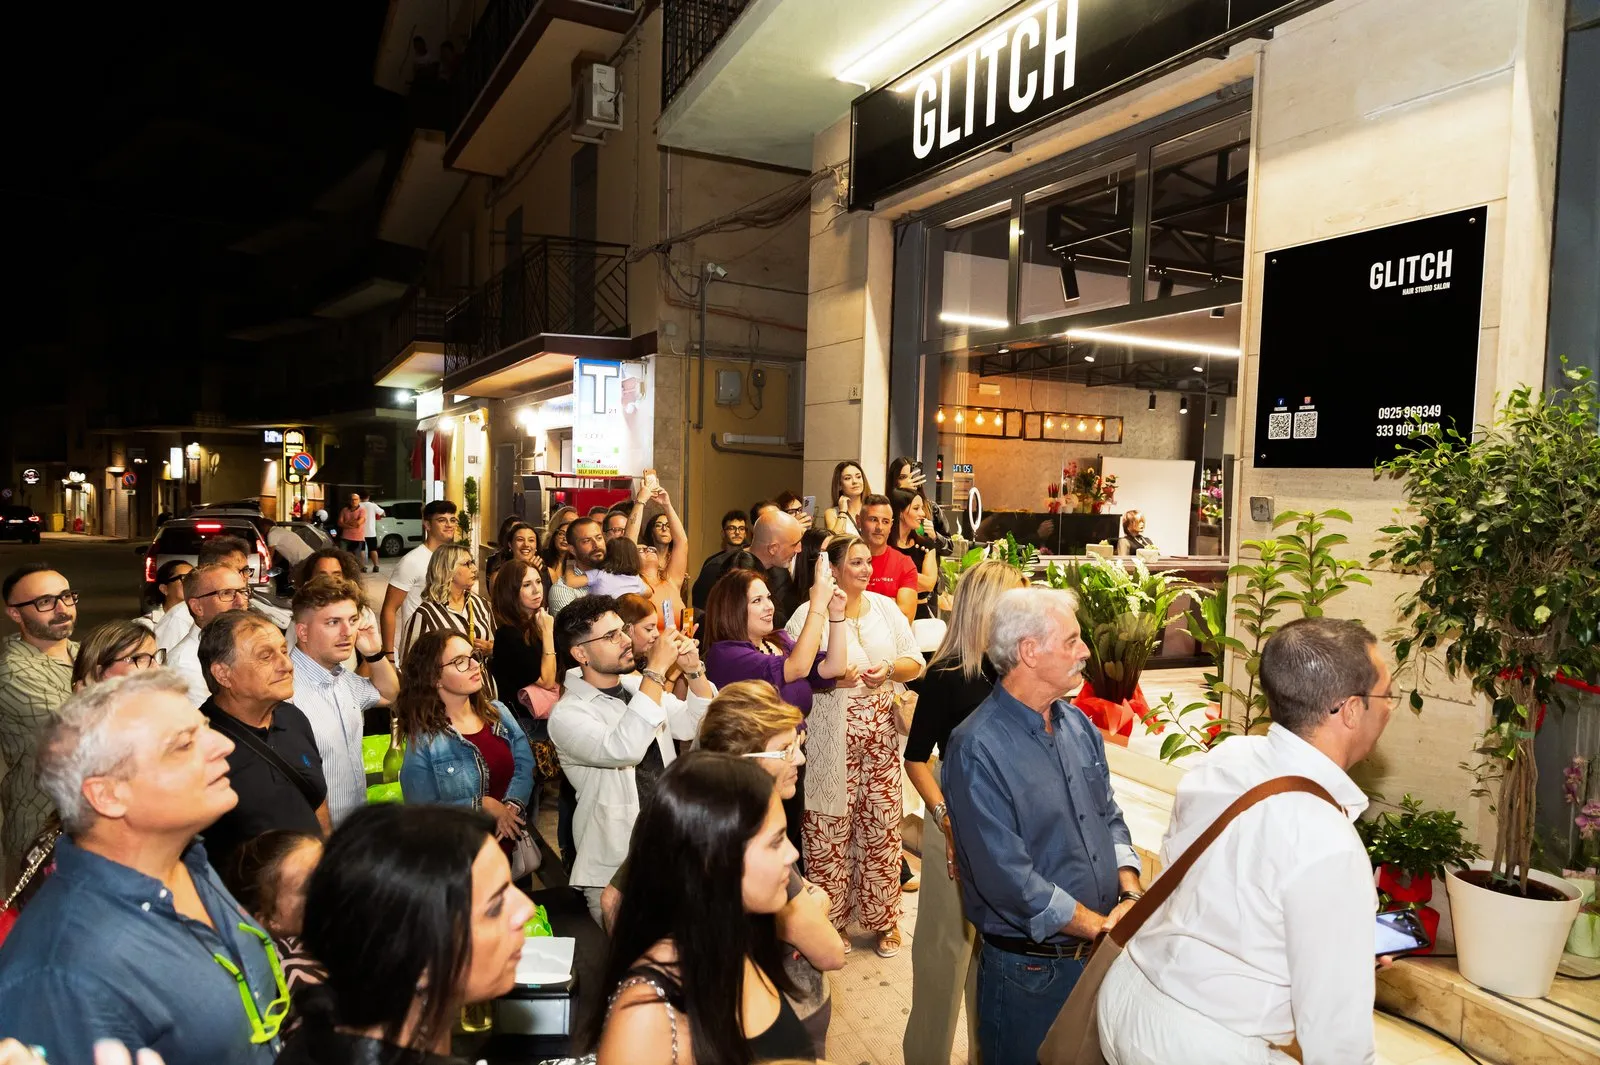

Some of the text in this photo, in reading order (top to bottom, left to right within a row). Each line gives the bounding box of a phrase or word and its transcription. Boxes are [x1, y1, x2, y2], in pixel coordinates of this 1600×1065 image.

[912, 0, 1079, 160] GLITCH
[1369, 248, 1453, 290] GLITCH
[1402, 281, 1451, 296] HAIR STUDIO SALON
[581, 363, 619, 414] T
[1378, 404, 1442, 419] 0925 969349
[1376, 424, 1394, 437] 333
